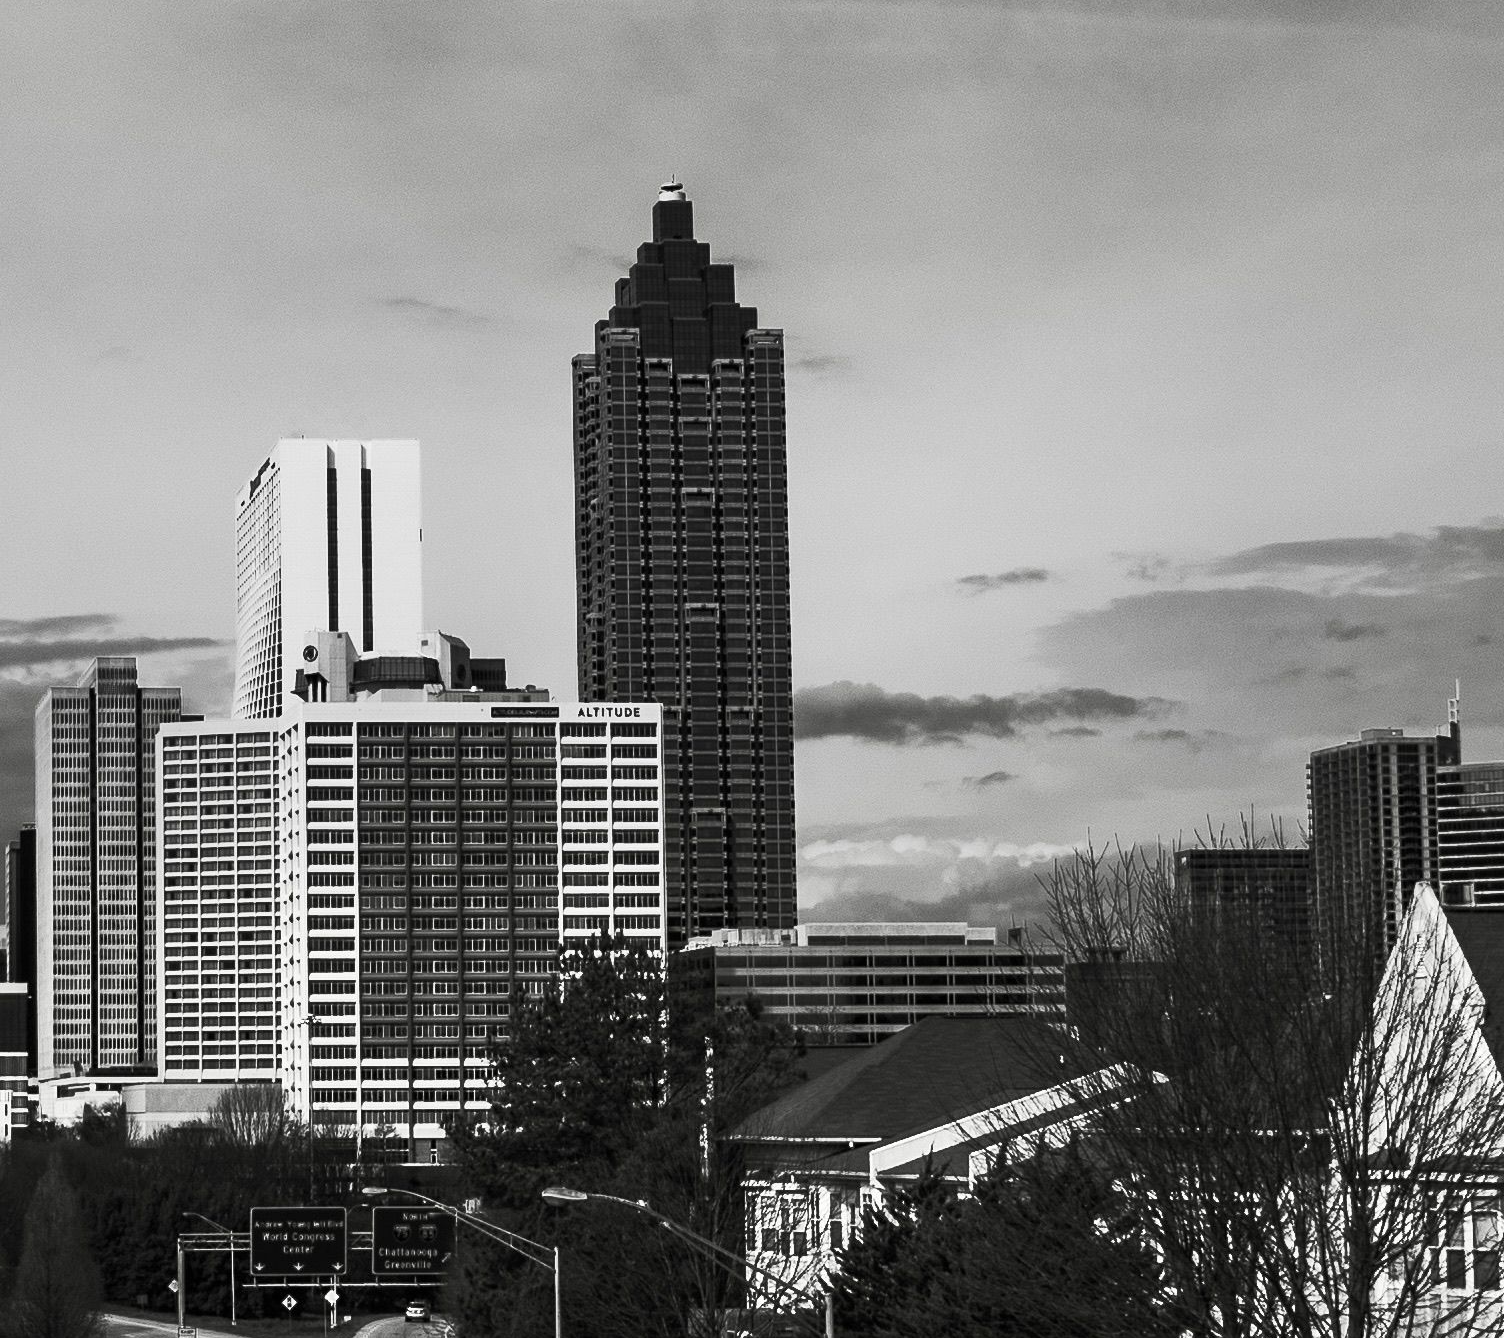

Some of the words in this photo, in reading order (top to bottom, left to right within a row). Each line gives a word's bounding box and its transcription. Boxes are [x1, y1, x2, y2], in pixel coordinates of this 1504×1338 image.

[577, 707, 640, 718] ALTITUDE
[262, 1232, 288, 1241] World
[291, 1232, 336, 1243] Congress
[282, 1245, 315, 1254] Center
[378, 1247, 438, 1259] Chattanooga
[384, 1260, 432, 1269] Greenville
